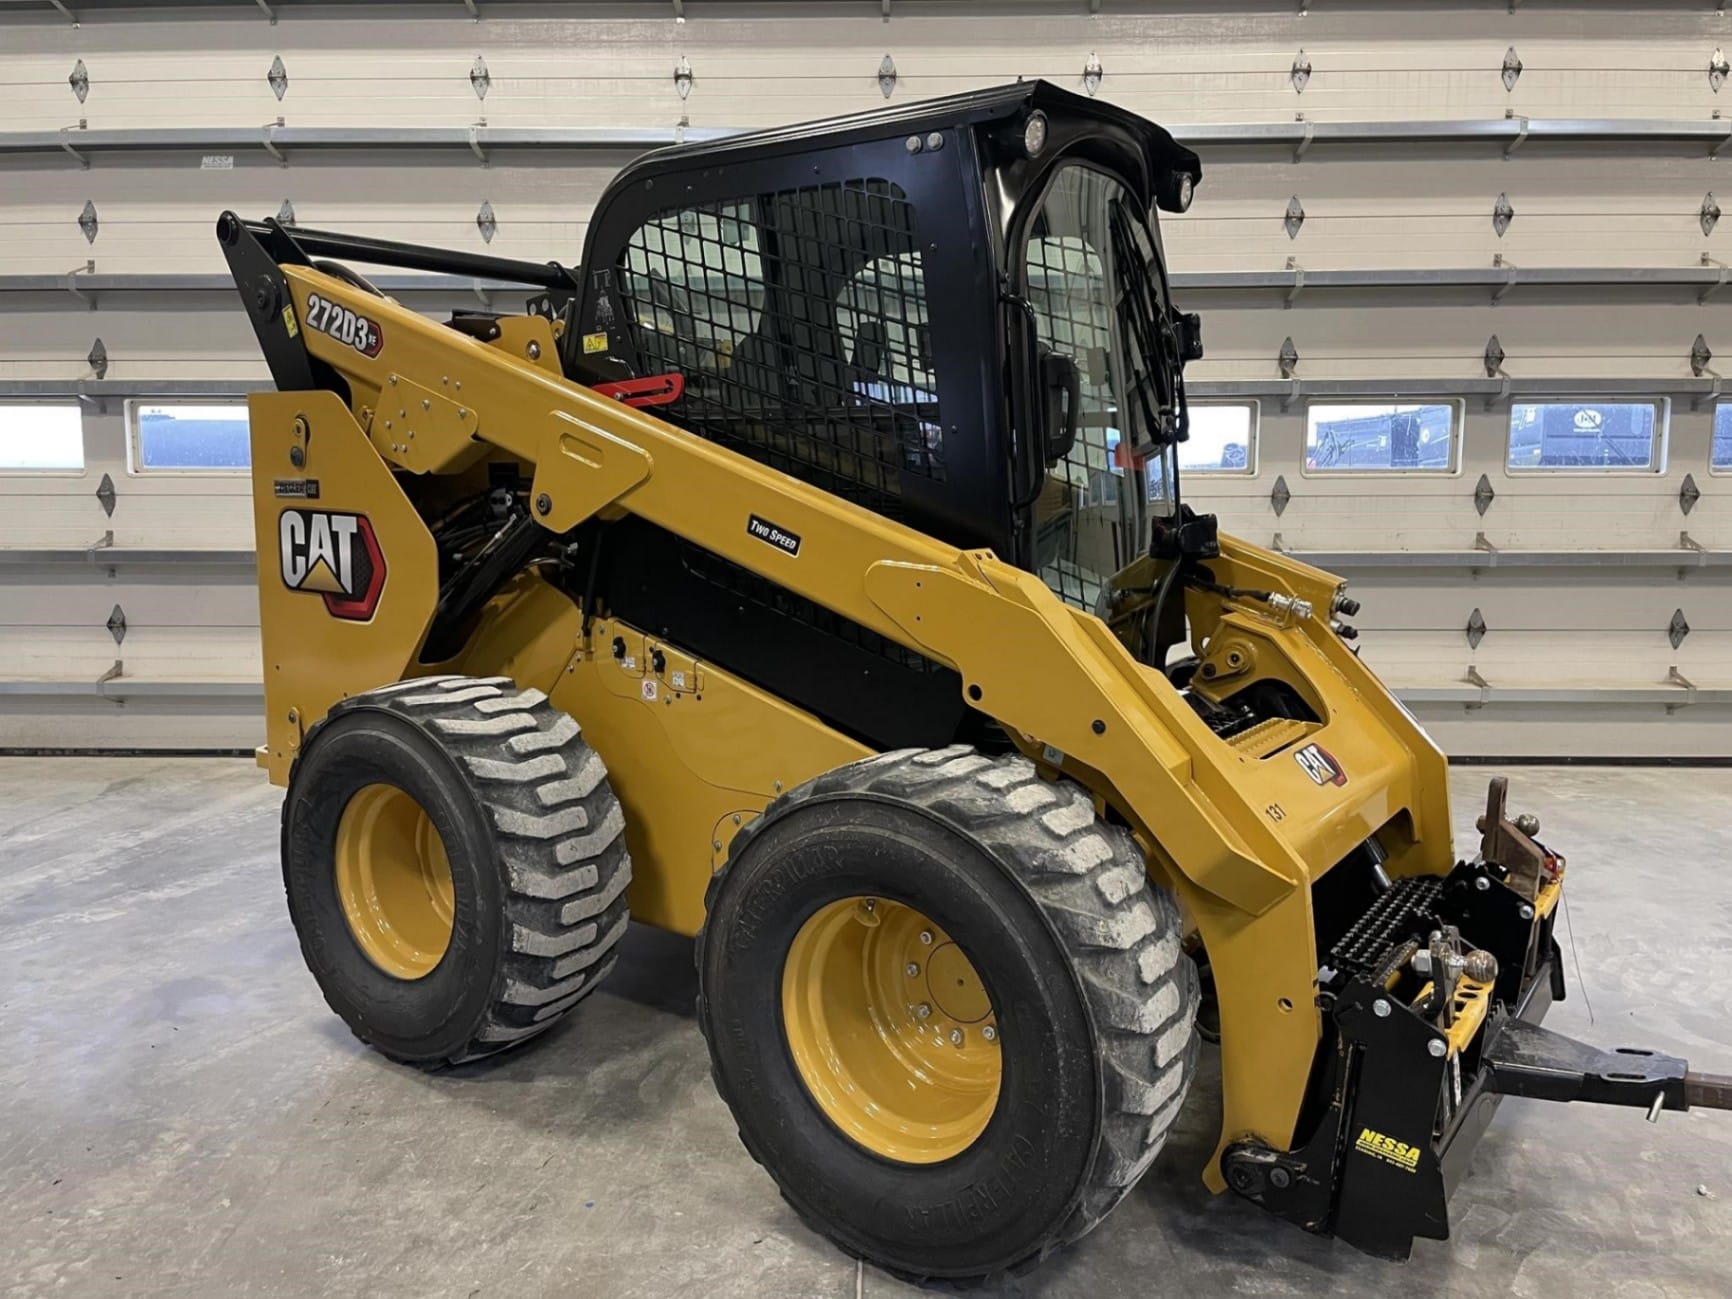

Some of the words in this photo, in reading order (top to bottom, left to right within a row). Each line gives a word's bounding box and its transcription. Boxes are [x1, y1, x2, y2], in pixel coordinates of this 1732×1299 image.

[306, 294, 369, 351] 272D3
[280, 510, 358, 594] CAT
[1294, 744, 1337, 784] CAT
[1265, 803, 1287, 823] 131
[1359, 1128, 1421, 1161] NESSA
